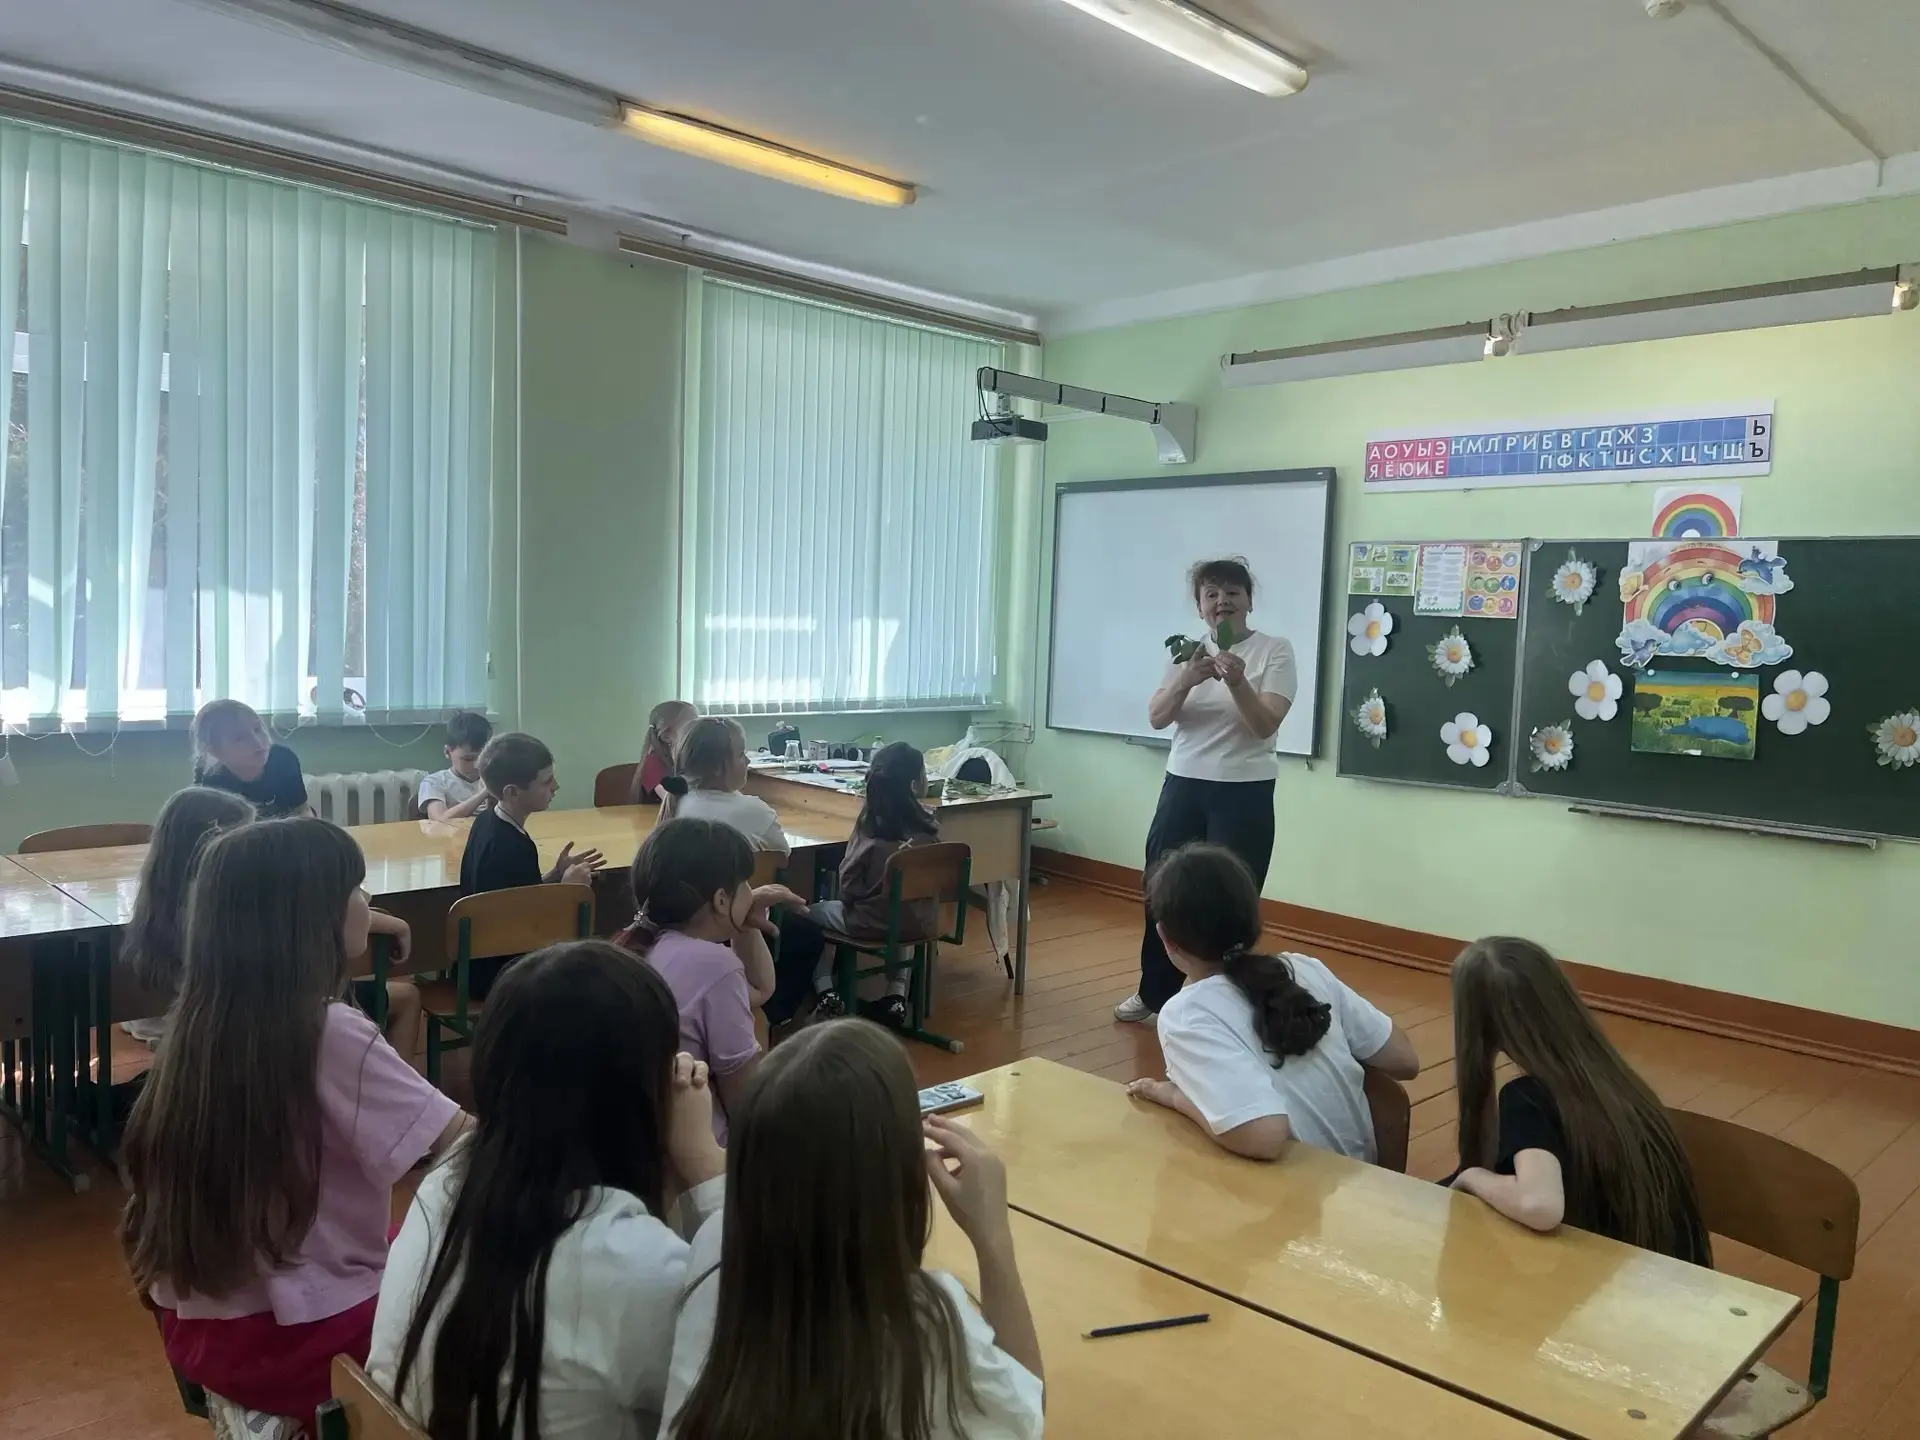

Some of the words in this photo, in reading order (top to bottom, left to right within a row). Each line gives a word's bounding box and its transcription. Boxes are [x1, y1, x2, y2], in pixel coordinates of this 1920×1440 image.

[1369, 447, 1380, 459] А
[1385, 445, 1397, 457] О
[1402, 444, 1413, 457] У
[1418, 443, 1430, 456] Ы
[1435, 441, 1446, 455] Э
[1451, 441, 1463, 454] Н
[1467, 439, 1481, 453] М
[1485, 438, 1498, 452] Л
[1507, 437, 1516, 451] Р
[1543, 435, 1552, 449] Б
[1561, 434, 1571, 448] В
[1581, 431, 1591, 447] Г
[1597, 430, 1612, 448] Д
[1617, 428, 1635, 444] Ж
[1641, 428, 1653, 443] З
[1754, 420, 1765, 435] Ь
[1369, 465, 1378, 478] Я
[1400, 463, 1413, 476] Ю
[1417, 462, 1429, 475] И
[1435, 461, 1444, 474] Е
[1540, 455, 1551, 469] П
[1558, 452, 1572, 467] Ф
[1579, 453, 1590, 467] К
[1601, 452, 1612, 465] Т
[1616, 450, 1634, 465] Ш
[1639, 449, 1651, 464] С
[1660, 448, 1673, 462] Х
[1682, 447, 1696, 463] Ц
[1704, 445, 1716, 459] Ч
[1723, 444, 1743, 461] Щ
[1750, 443, 1764, 457] Ъ
